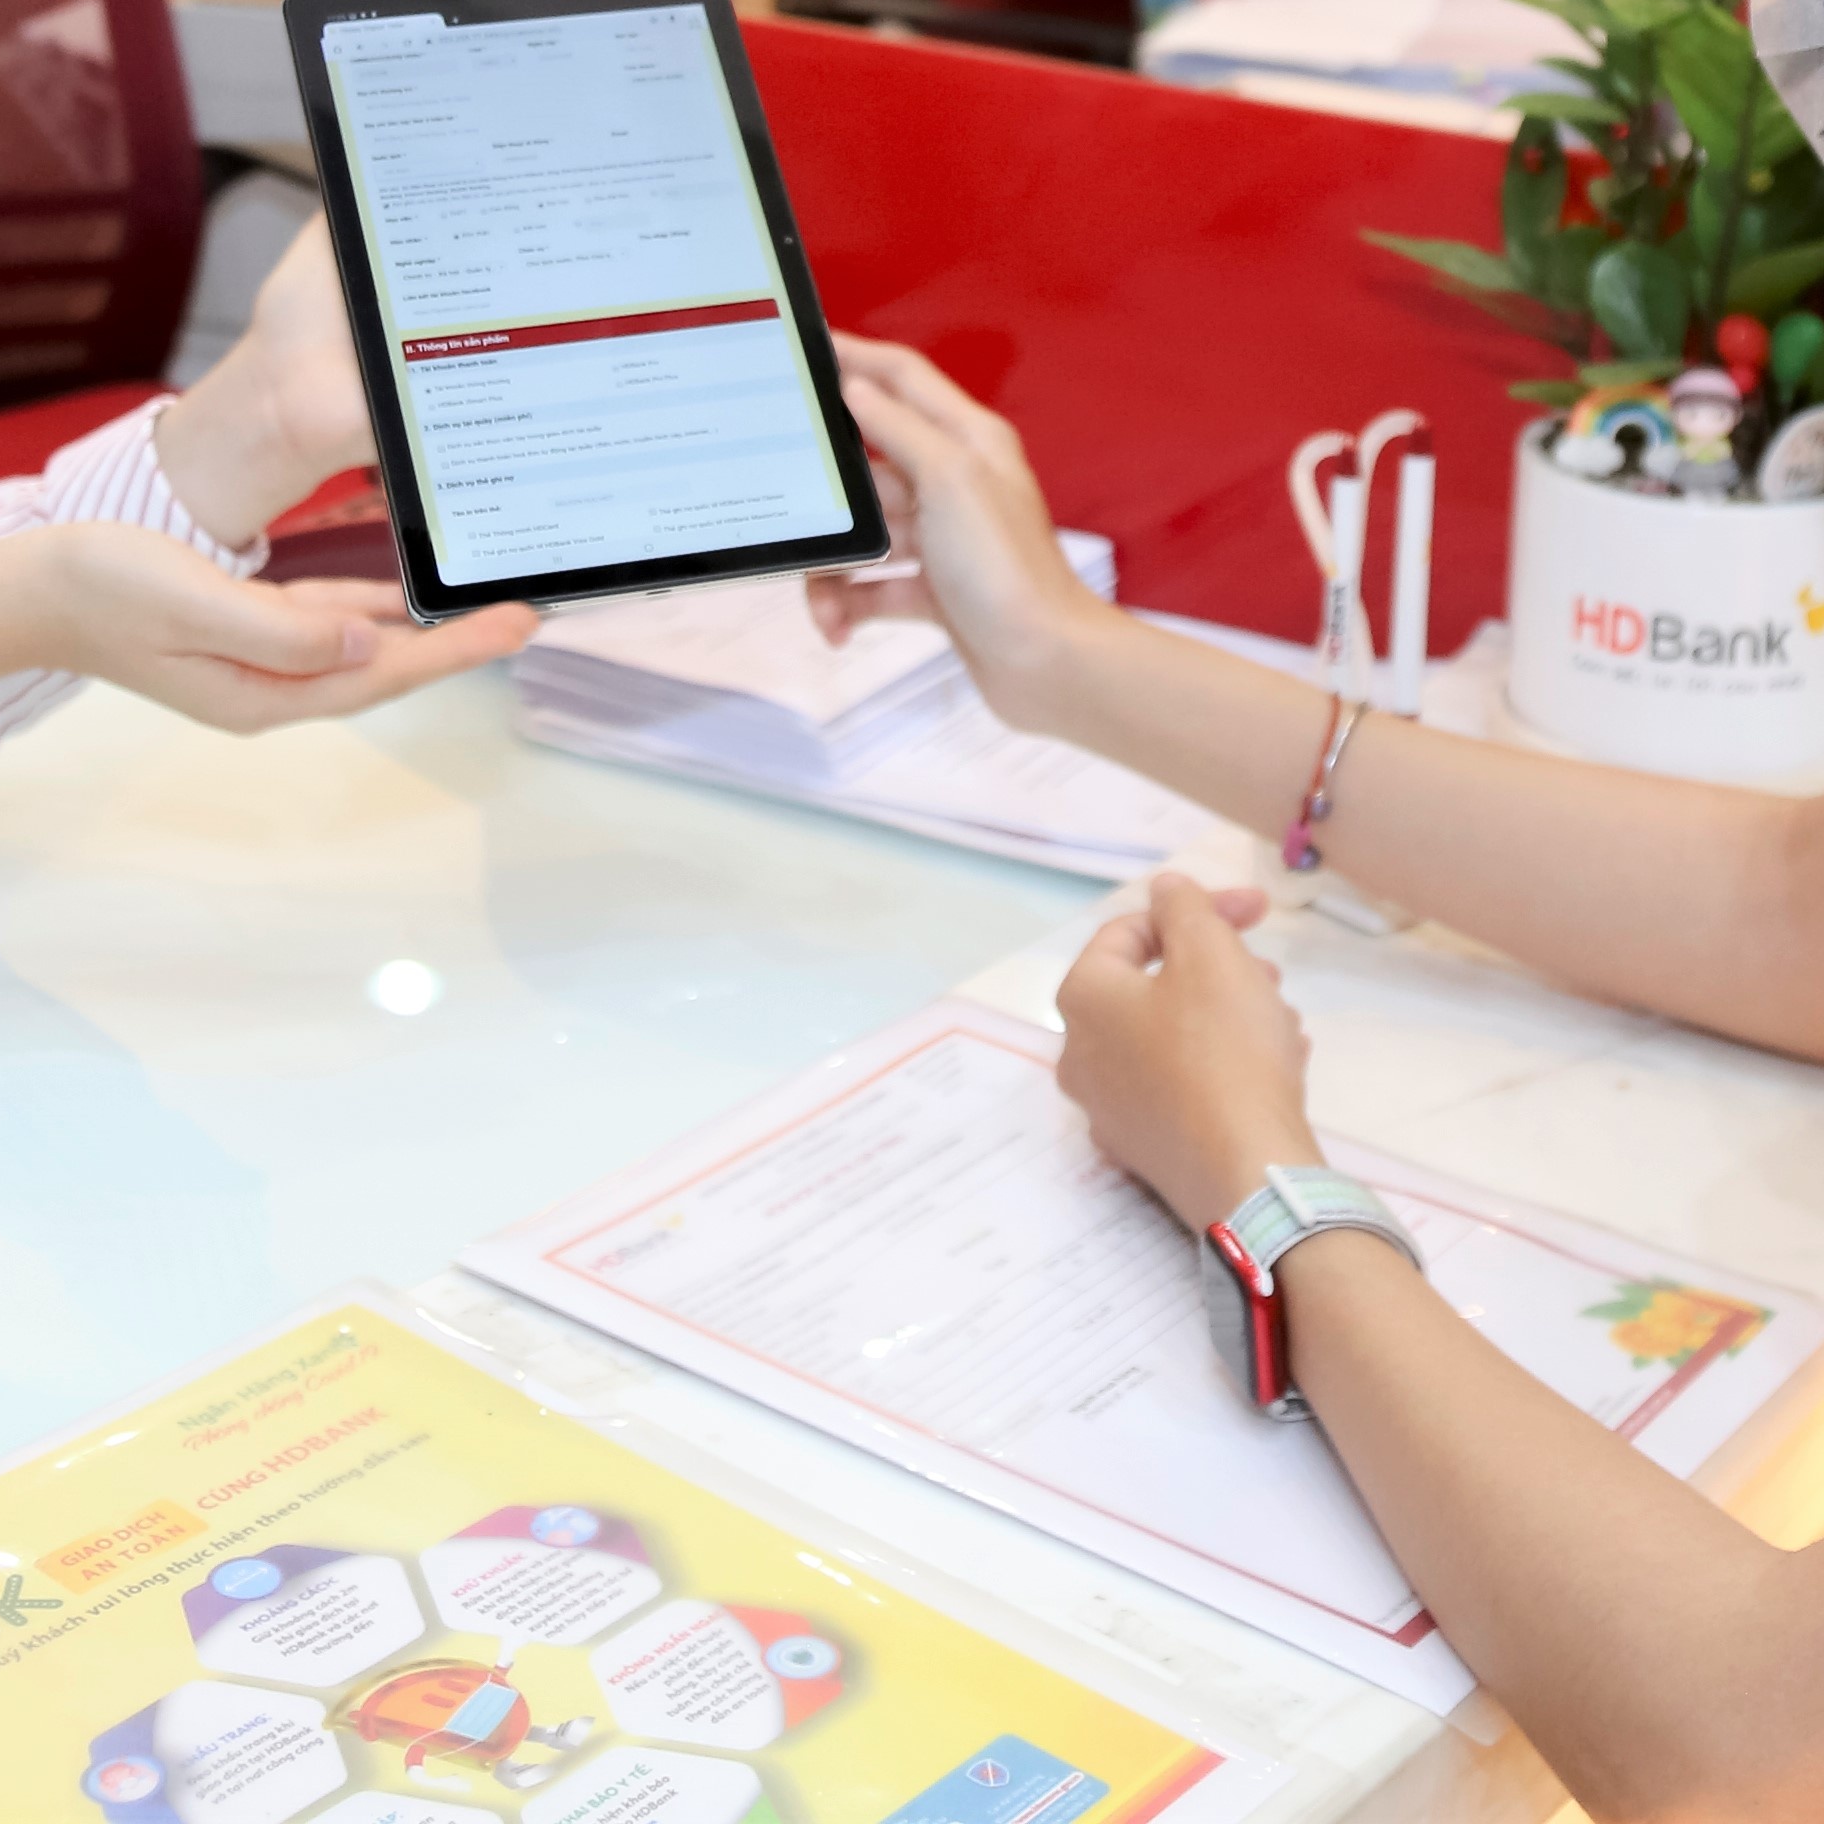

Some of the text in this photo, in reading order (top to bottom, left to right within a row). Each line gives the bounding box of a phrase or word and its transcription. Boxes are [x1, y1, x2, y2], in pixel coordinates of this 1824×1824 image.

[1571, 593, 1793, 668] HDBank
[197, 1408, 384, 1509] CÙNG HDBANK
[20, 1616, 86, 1650] khách
[86, 1594, 121, 1615] vui
[117, 1572, 170, 1598] lòng
[166, 1549, 214, 1574] thực
[209, 1526, 256, 1550] hiện
[255, 1502, 300, 1527] theo
[298, 1468, 364, 1502] hướng
[362, 1449, 398, 1469] dẫn
[398, 1433, 430, 1450] sau
[60, 1511, 166, 1566] GIAO DỊCH
[81, 1524, 186, 1580] AN TOÀN
